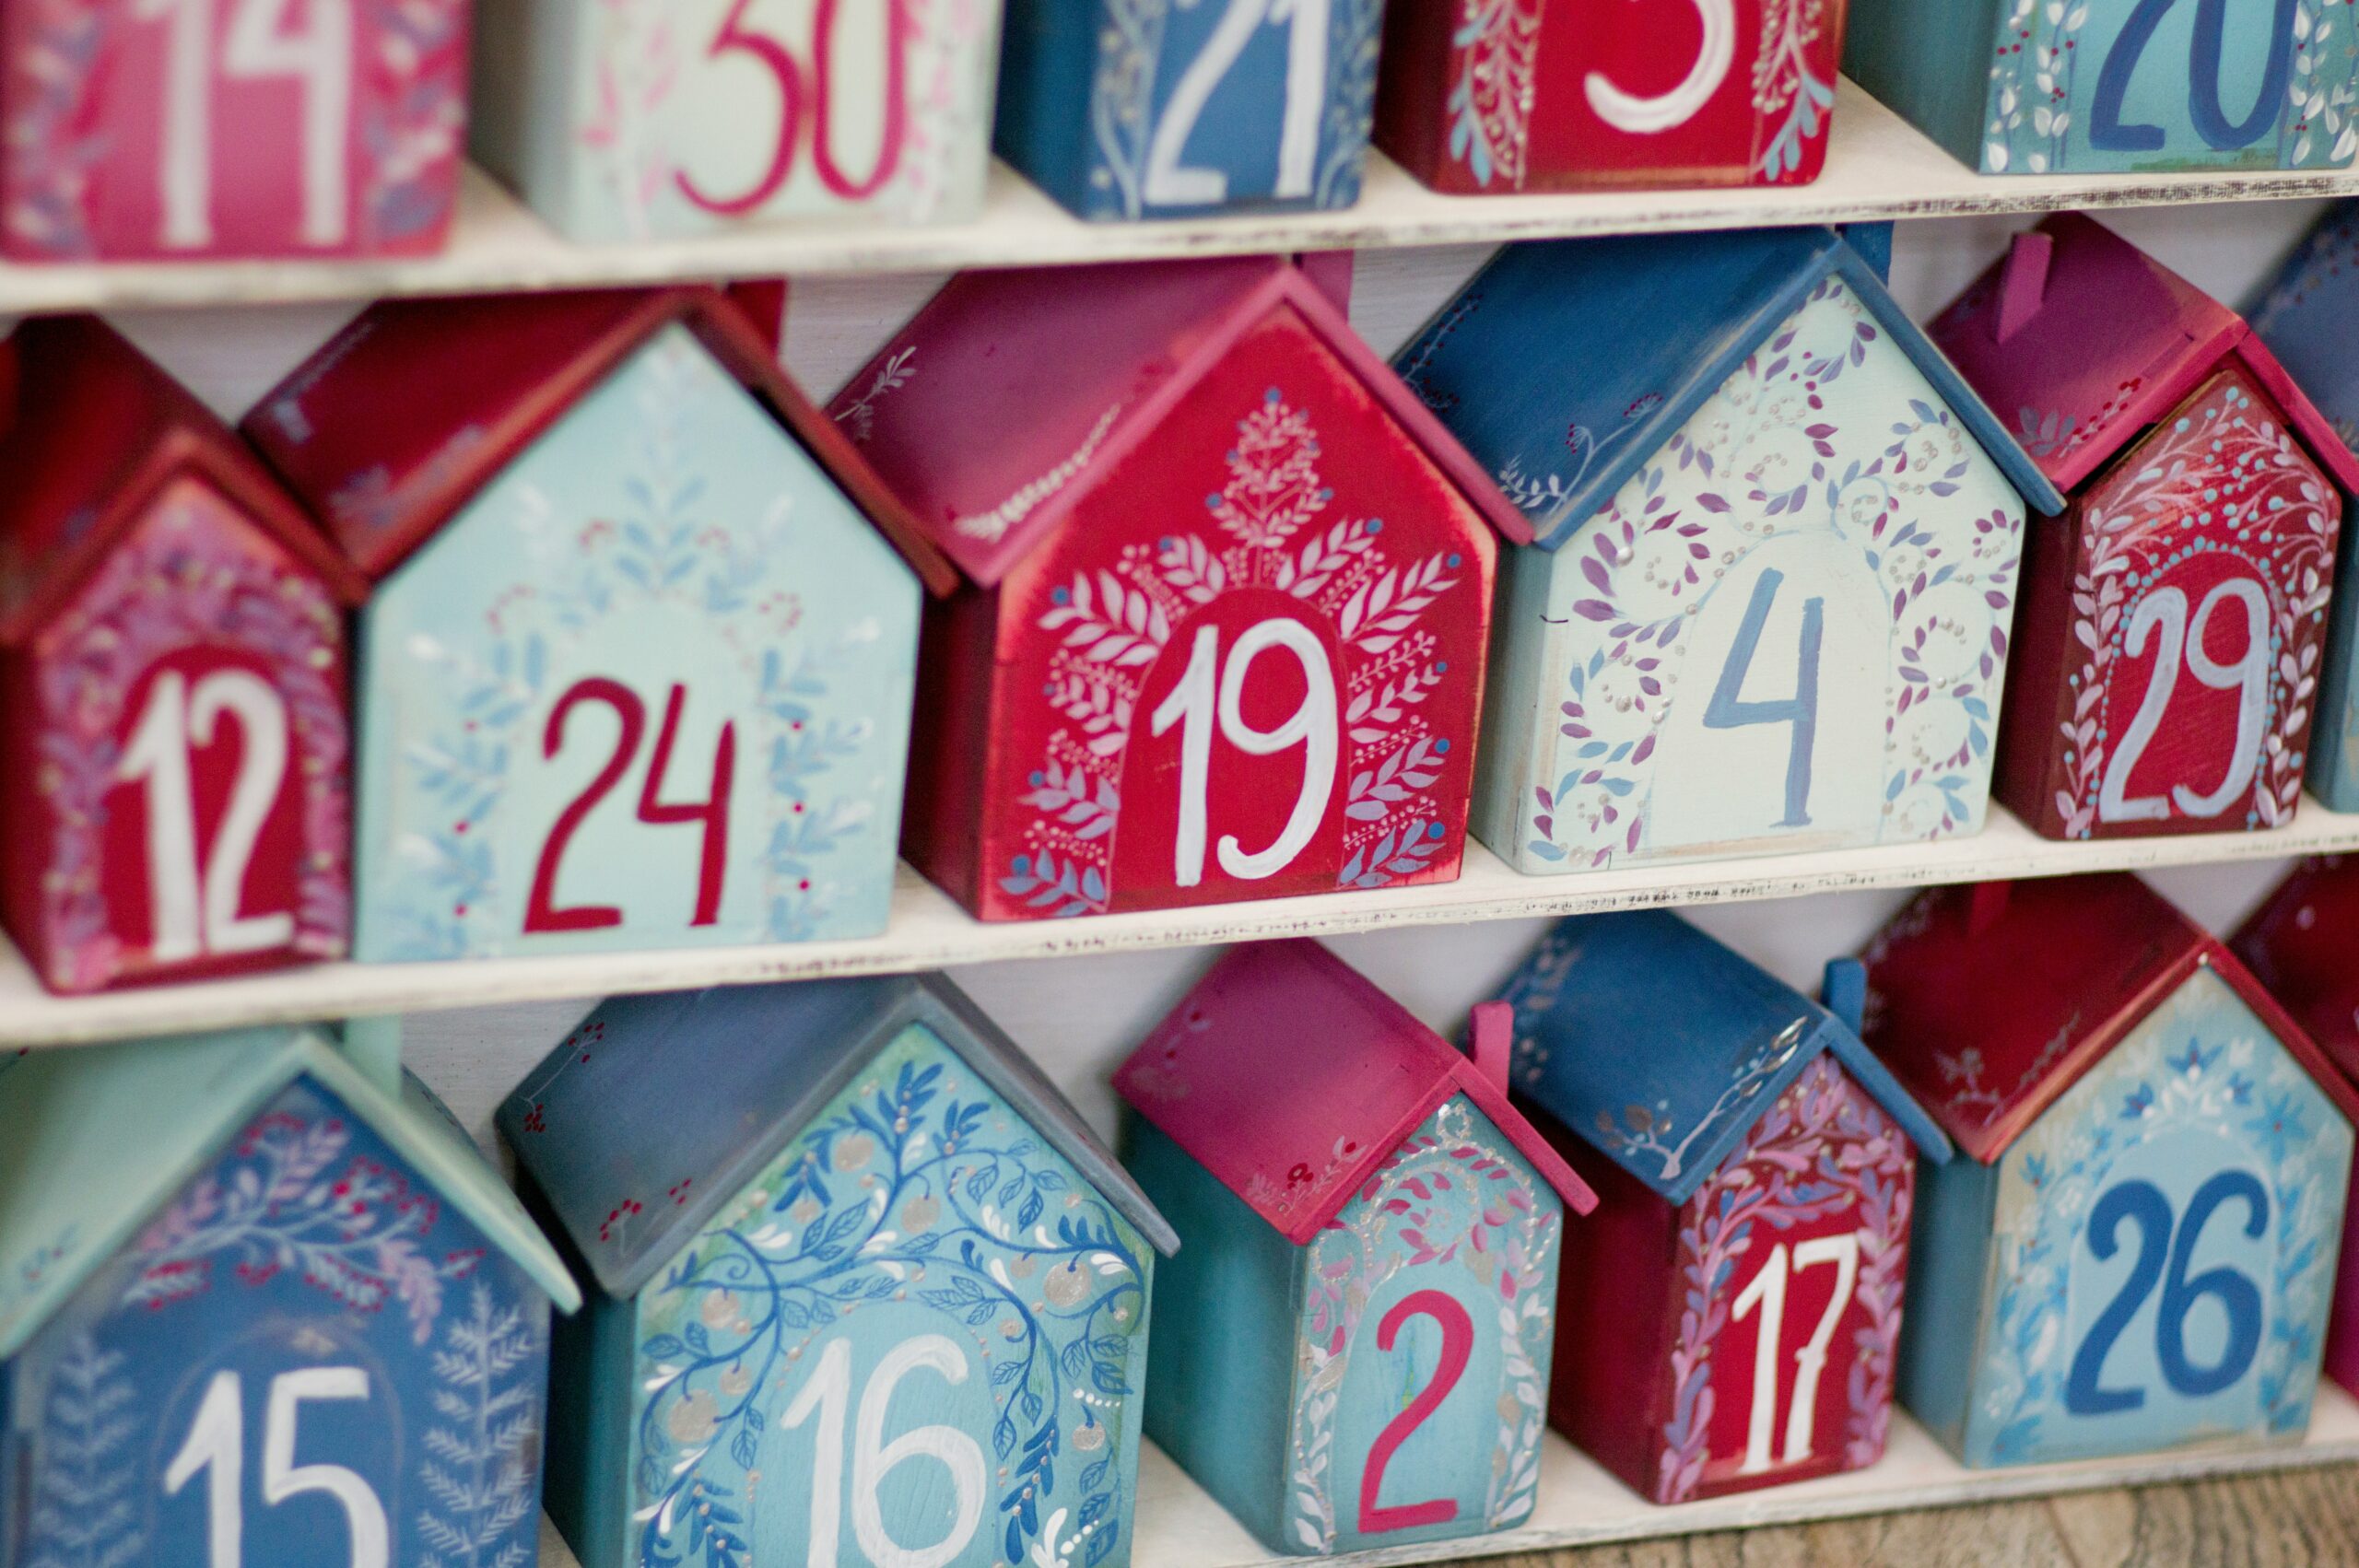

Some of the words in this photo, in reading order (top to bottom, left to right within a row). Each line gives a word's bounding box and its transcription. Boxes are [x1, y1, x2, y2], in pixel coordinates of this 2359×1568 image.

[130, 0, 356, 249] 14
[675, 0, 908, 217] 30
[1144, 0, 1329, 205] 21
[2090, 0, 2296, 151] 20
[114, 669, 295, 960] 12
[523, 675, 735, 934] 24
[1151, 617, 1338, 886] 19
[1702, 568, 1825, 828] 4
[2099, 578, 2271, 823] 29
[1358, 1290, 1474, 1533] 2
[1731, 1233, 1860, 1474] 17
[2065, 1170, 2270, 1417] 26
[164, 1366, 389, 1568] 15
[780, 1334, 987, 1568] 16
